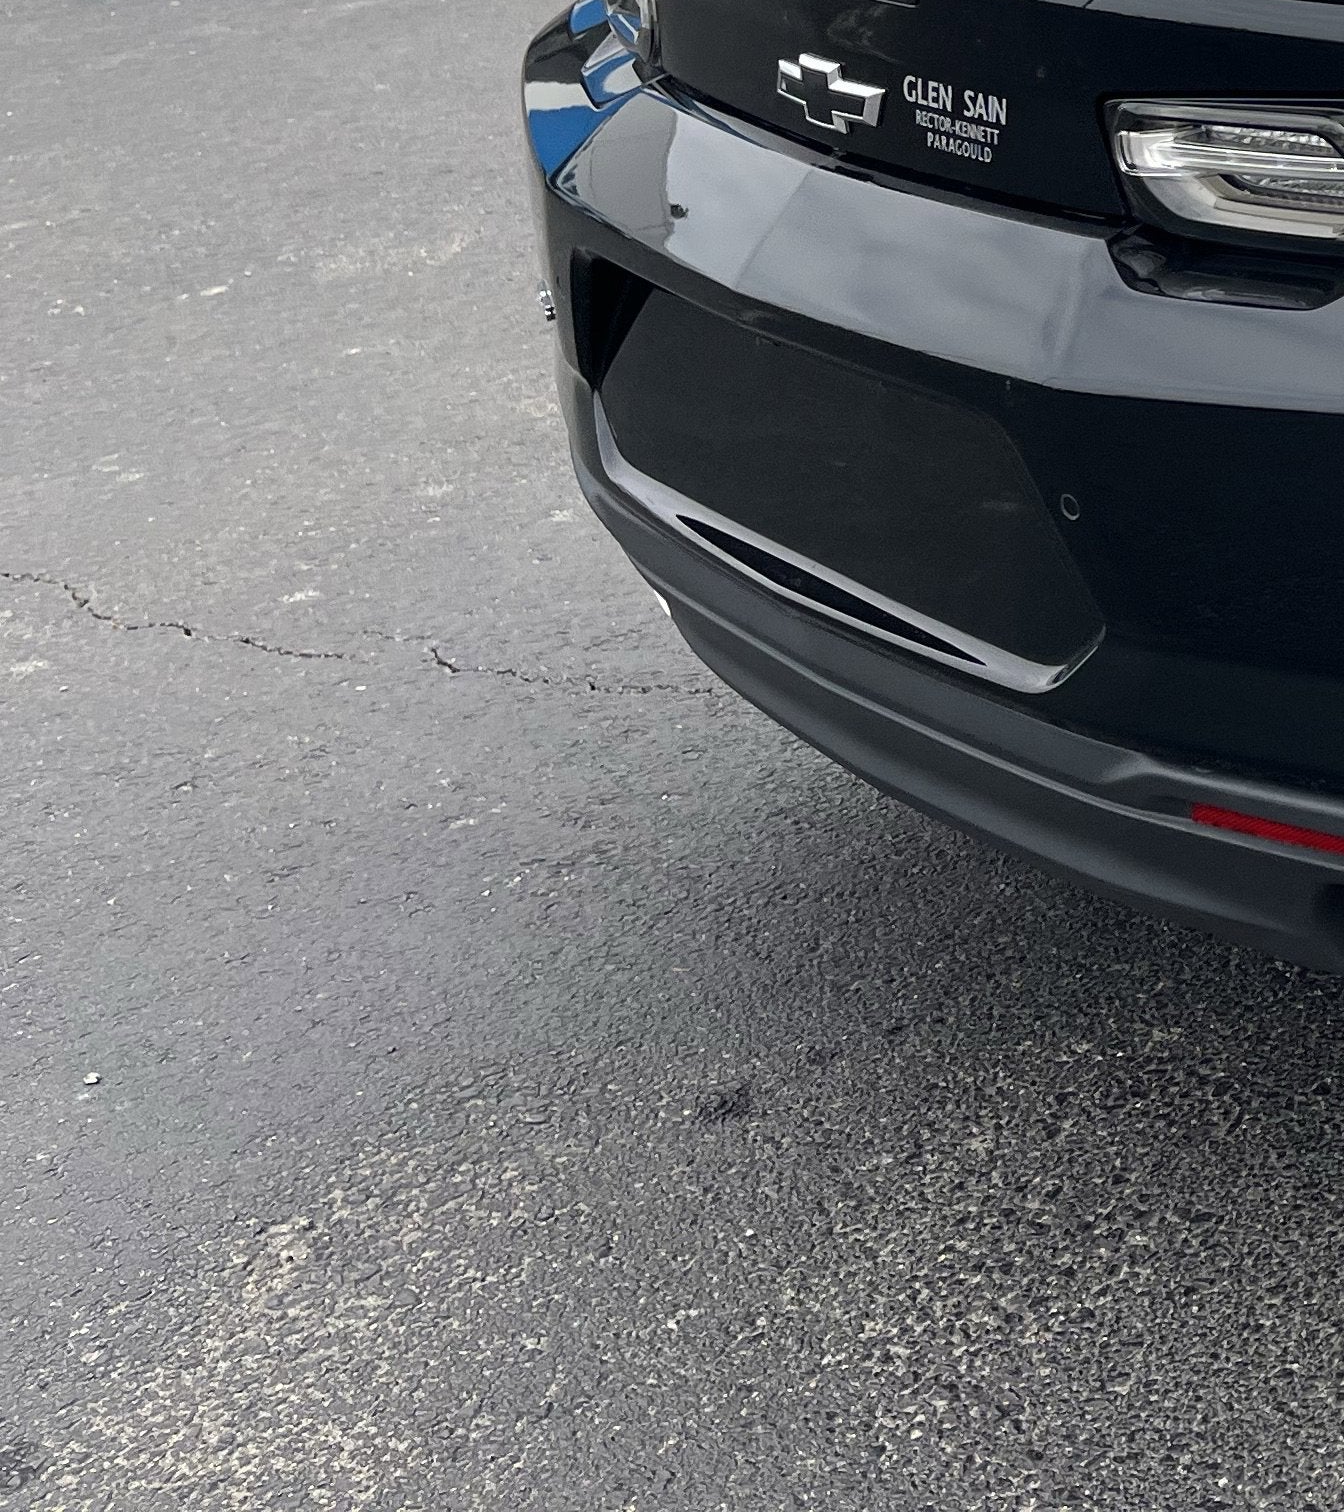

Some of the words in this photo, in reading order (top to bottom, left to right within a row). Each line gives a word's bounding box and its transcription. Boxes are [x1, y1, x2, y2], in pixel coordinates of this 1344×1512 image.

[903, 75, 952, 112] GLEN
[963, 90, 1007, 125] SAIN
[916, 109, 999, 145] RECTOR-KENNETT
[927, 131, 992, 163] PARAGOULD
